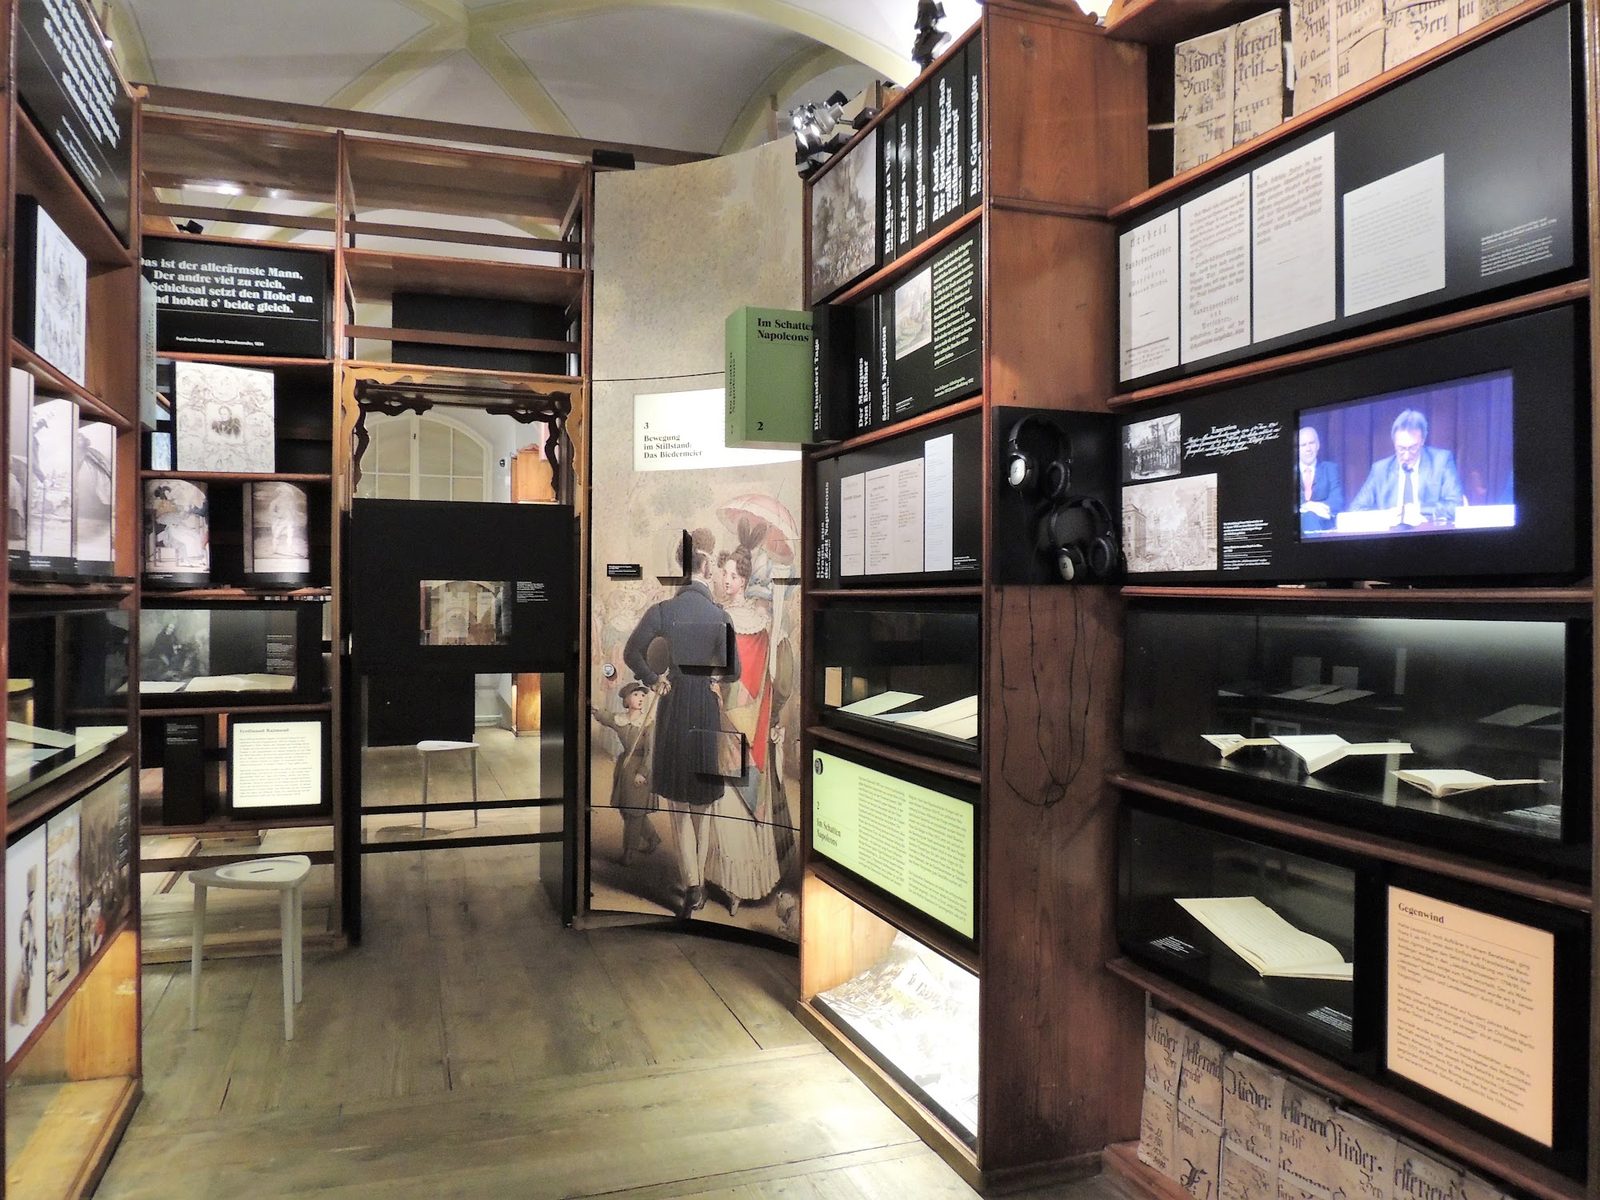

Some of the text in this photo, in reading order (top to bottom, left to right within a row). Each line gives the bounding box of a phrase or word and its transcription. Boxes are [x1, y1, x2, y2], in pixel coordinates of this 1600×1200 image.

[970, 74, 979, 166] Grimmingtor
[952, 108, 960, 210] Freiheitskampf
[886, 173, 891, 188] in
[161, 259, 176, 268] ist
[179, 261, 198, 270] der
[200, 262, 265, 276] allerärmste
[268, 268, 303, 280] Mann,
[153, 270, 286, 290] Der andre viel zu reich.
[150, 282, 313, 303] Schicksal setzt den Hobel an
[156, 295, 169, 304] nd
[171, 296, 208, 307] hobelt
[224, 300, 254, 310] beide
[257, 302, 294, 313] gleich.
[757, 318, 771, 327] Im
[758, 330, 809, 342] Napoleons
[757, 422, 764, 431] 2
[1398, 902, 1444, 924] Gegenwind
